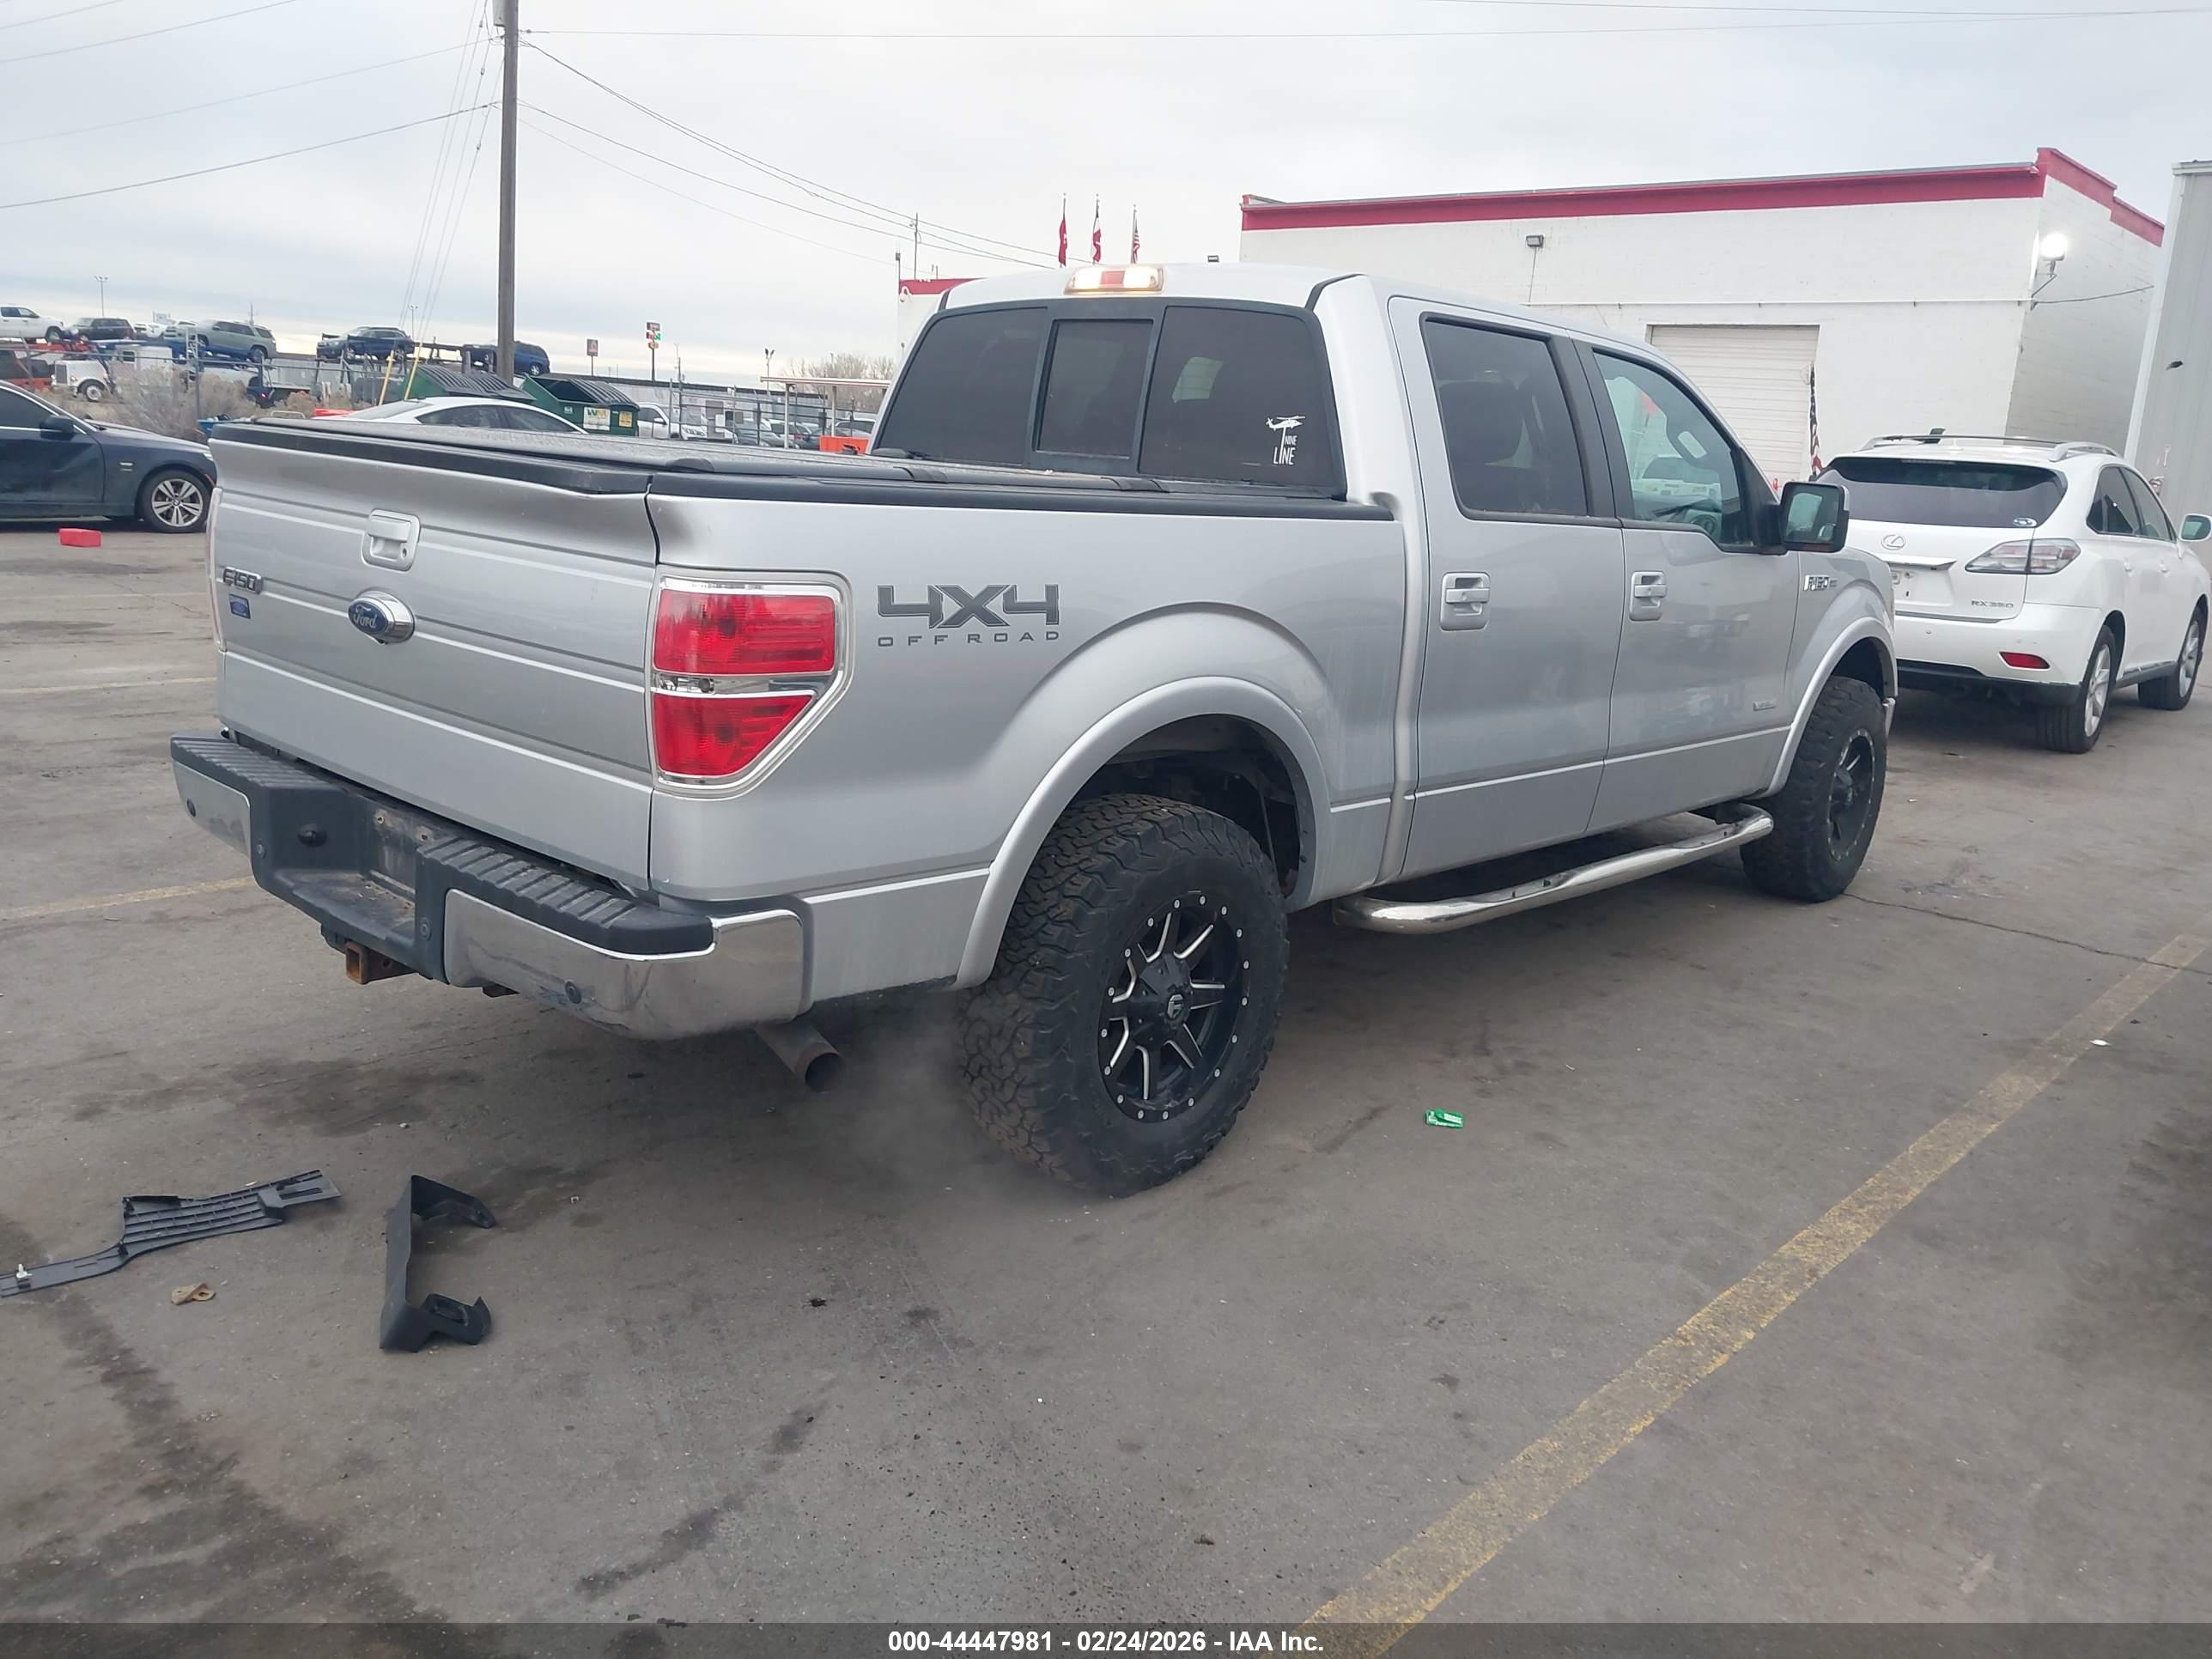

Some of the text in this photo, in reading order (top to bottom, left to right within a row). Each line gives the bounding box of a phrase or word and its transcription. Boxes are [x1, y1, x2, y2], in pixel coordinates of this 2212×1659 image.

[1284, 434, 1297, 446] NINE
[1273, 446, 1296, 465] LINE
[353, 604, 378, 629] Ford
[878, 584, 1060, 629] 4X4
